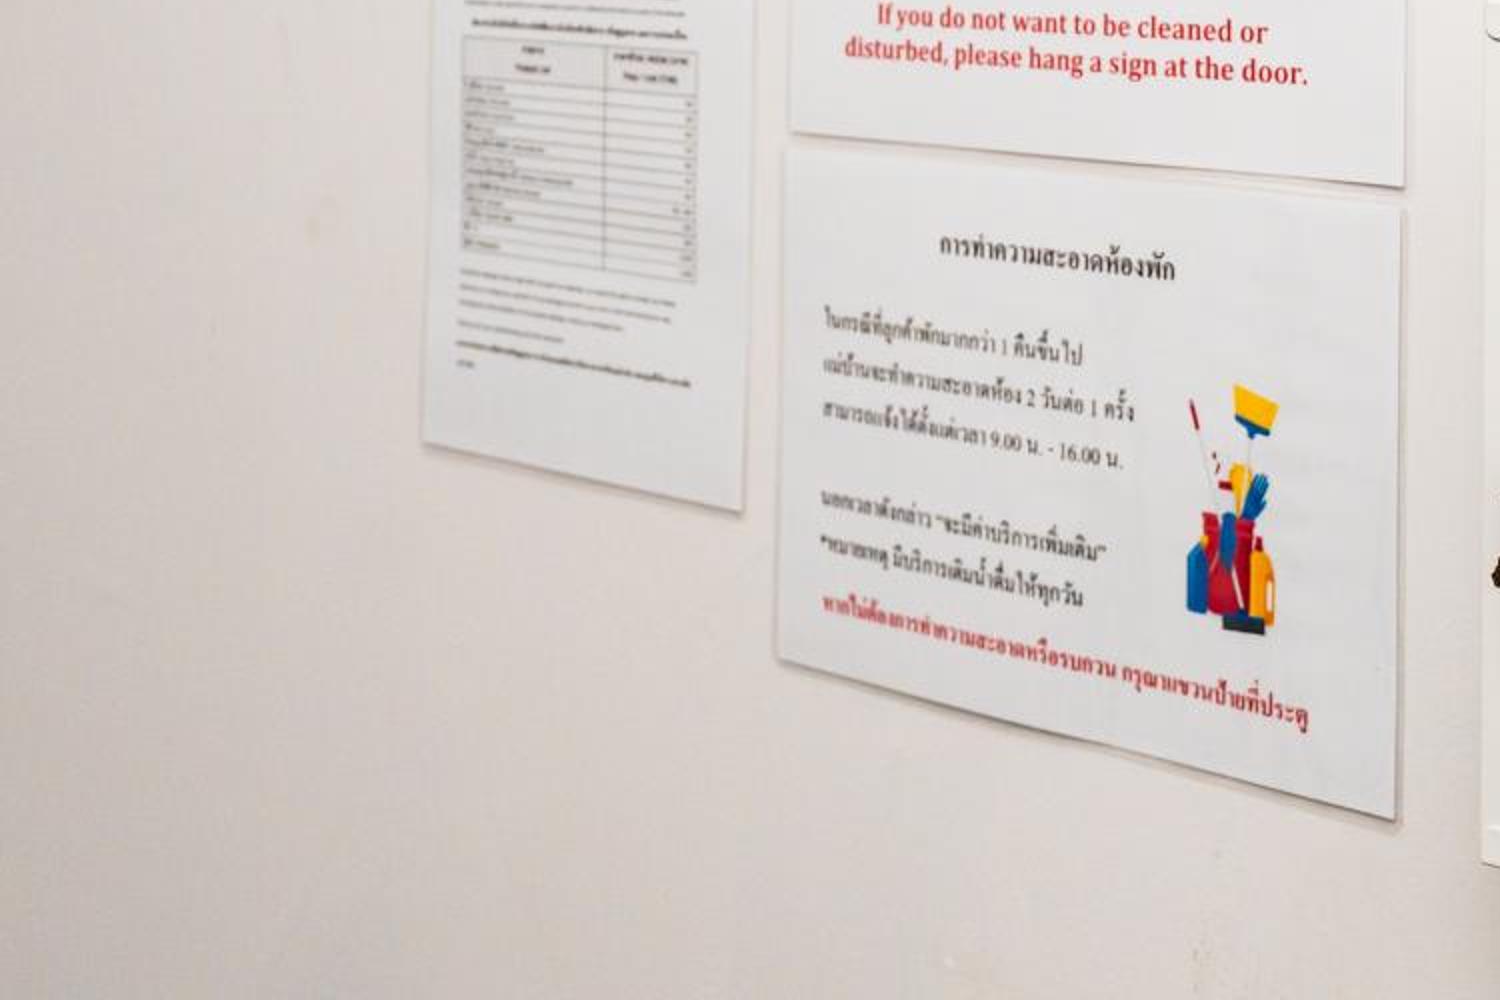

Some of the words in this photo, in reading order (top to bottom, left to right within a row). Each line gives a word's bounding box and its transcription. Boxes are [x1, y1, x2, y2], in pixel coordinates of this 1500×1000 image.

[878, 3, 893, 25] If
[896, 9, 934, 31] you
[939, 5, 965, 29] do
[971, 11, 1006, 31] not
[1012, 14, 1067, 35] want
[1073, 14, 1096, 36] to
[1103, 13, 1131, 38] be
[1137, 15, 1233, 43] cleaned
[1240, 25, 1269, 44] or
[845, 35, 948, 66] disturbed,
[954, 43, 1022, 71] please
[1029, 46, 1084, 79] hang
[1089, 56, 1102, 73] a
[1109, 52, 1157, 82] sign
[1164, 57, 1188, 79] at
[1195, 55, 1234, 81] the
[1241, 57, 1308, 86] door.
[940, 233, 1175, 281] การทำความสะอาดห้องพัก
[1027, 389, 1035, 408] 2
[1104, 391, 1134, 422] ครั้ง
[990, 431, 1022, 452] 9.00
[1060, 443, 1101, 466] 16.00
